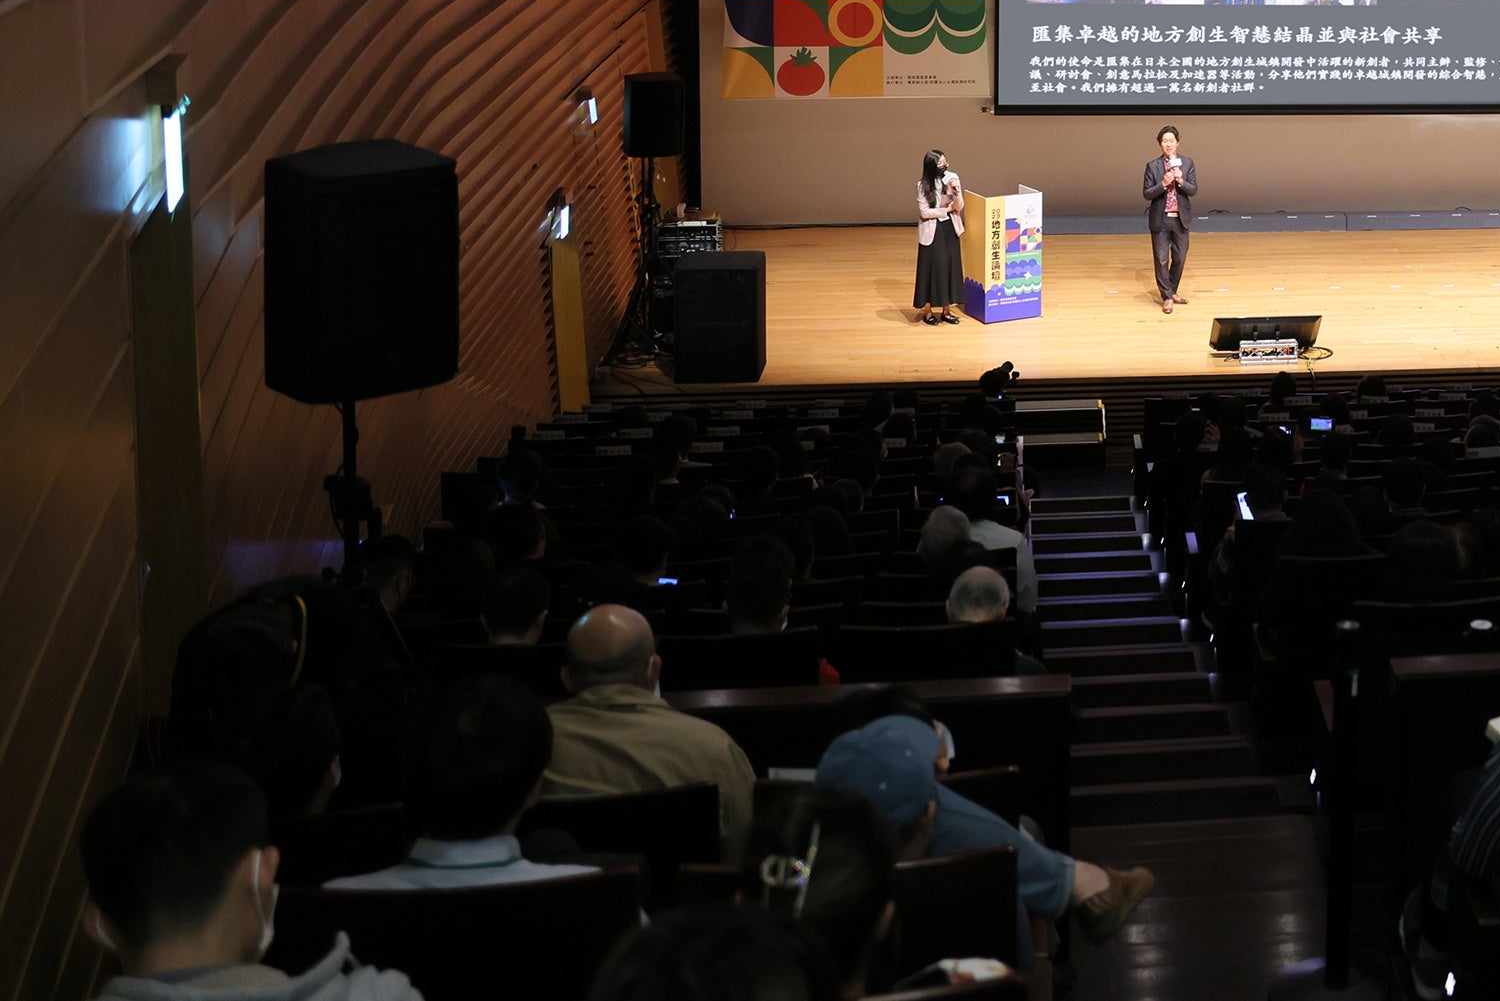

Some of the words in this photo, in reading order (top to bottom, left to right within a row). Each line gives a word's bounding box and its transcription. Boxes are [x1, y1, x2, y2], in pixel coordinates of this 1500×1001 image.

[1032, 24, 1443, 45] 匯集卓越的地方創生智慧結晶並與社會共享
